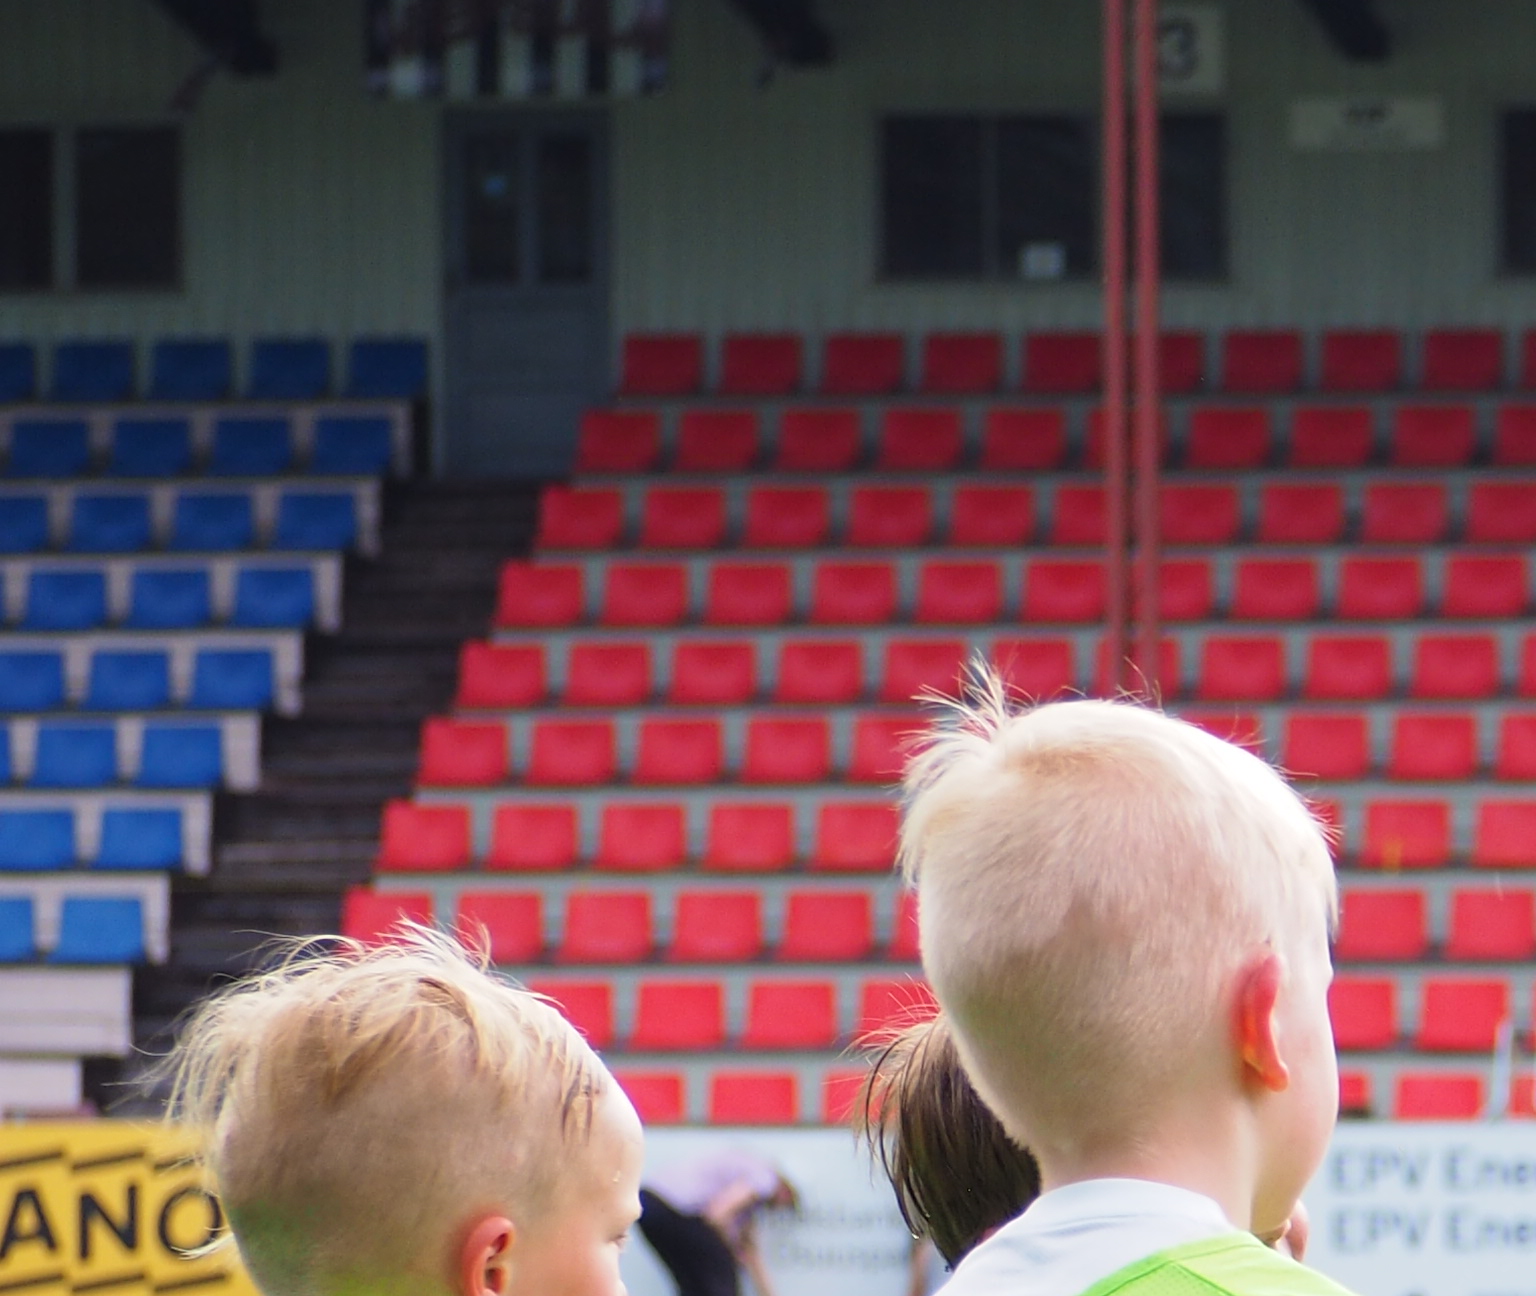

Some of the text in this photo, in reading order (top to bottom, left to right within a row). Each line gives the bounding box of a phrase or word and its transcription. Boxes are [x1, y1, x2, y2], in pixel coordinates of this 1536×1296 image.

[1158, 20, 1197, 79] 3
[1330, 1147, 1428, 1192] EPV
[1330, 1209, 1428, 1252] EPV
